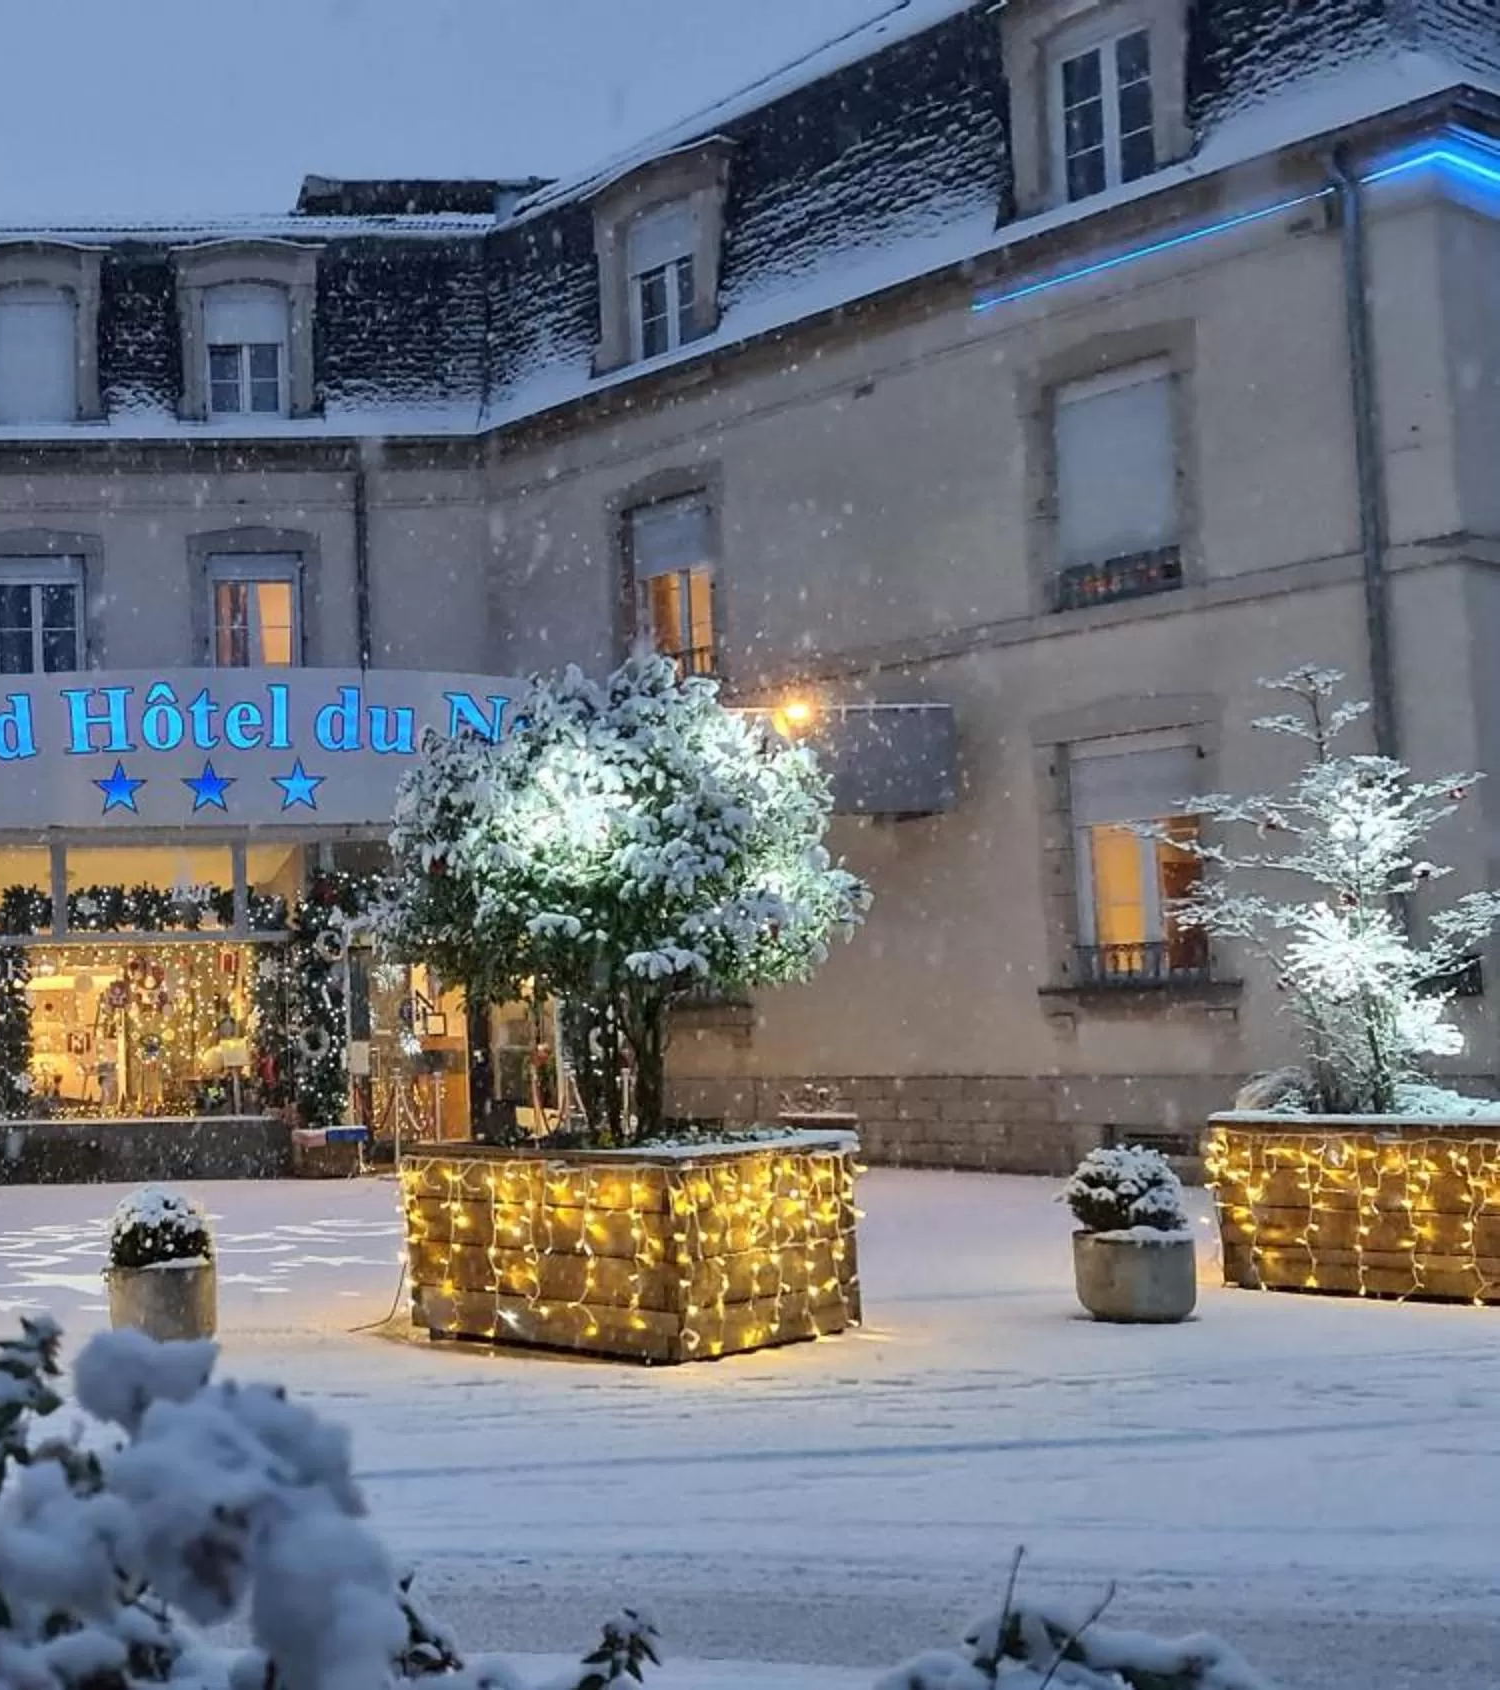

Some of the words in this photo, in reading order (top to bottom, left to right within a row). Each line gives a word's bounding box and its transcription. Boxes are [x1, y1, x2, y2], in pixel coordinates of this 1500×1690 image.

[60, 681, 292, 755] Hôtel
[313, 685, 416, 754] du
[441, 691, 532, 748] N
